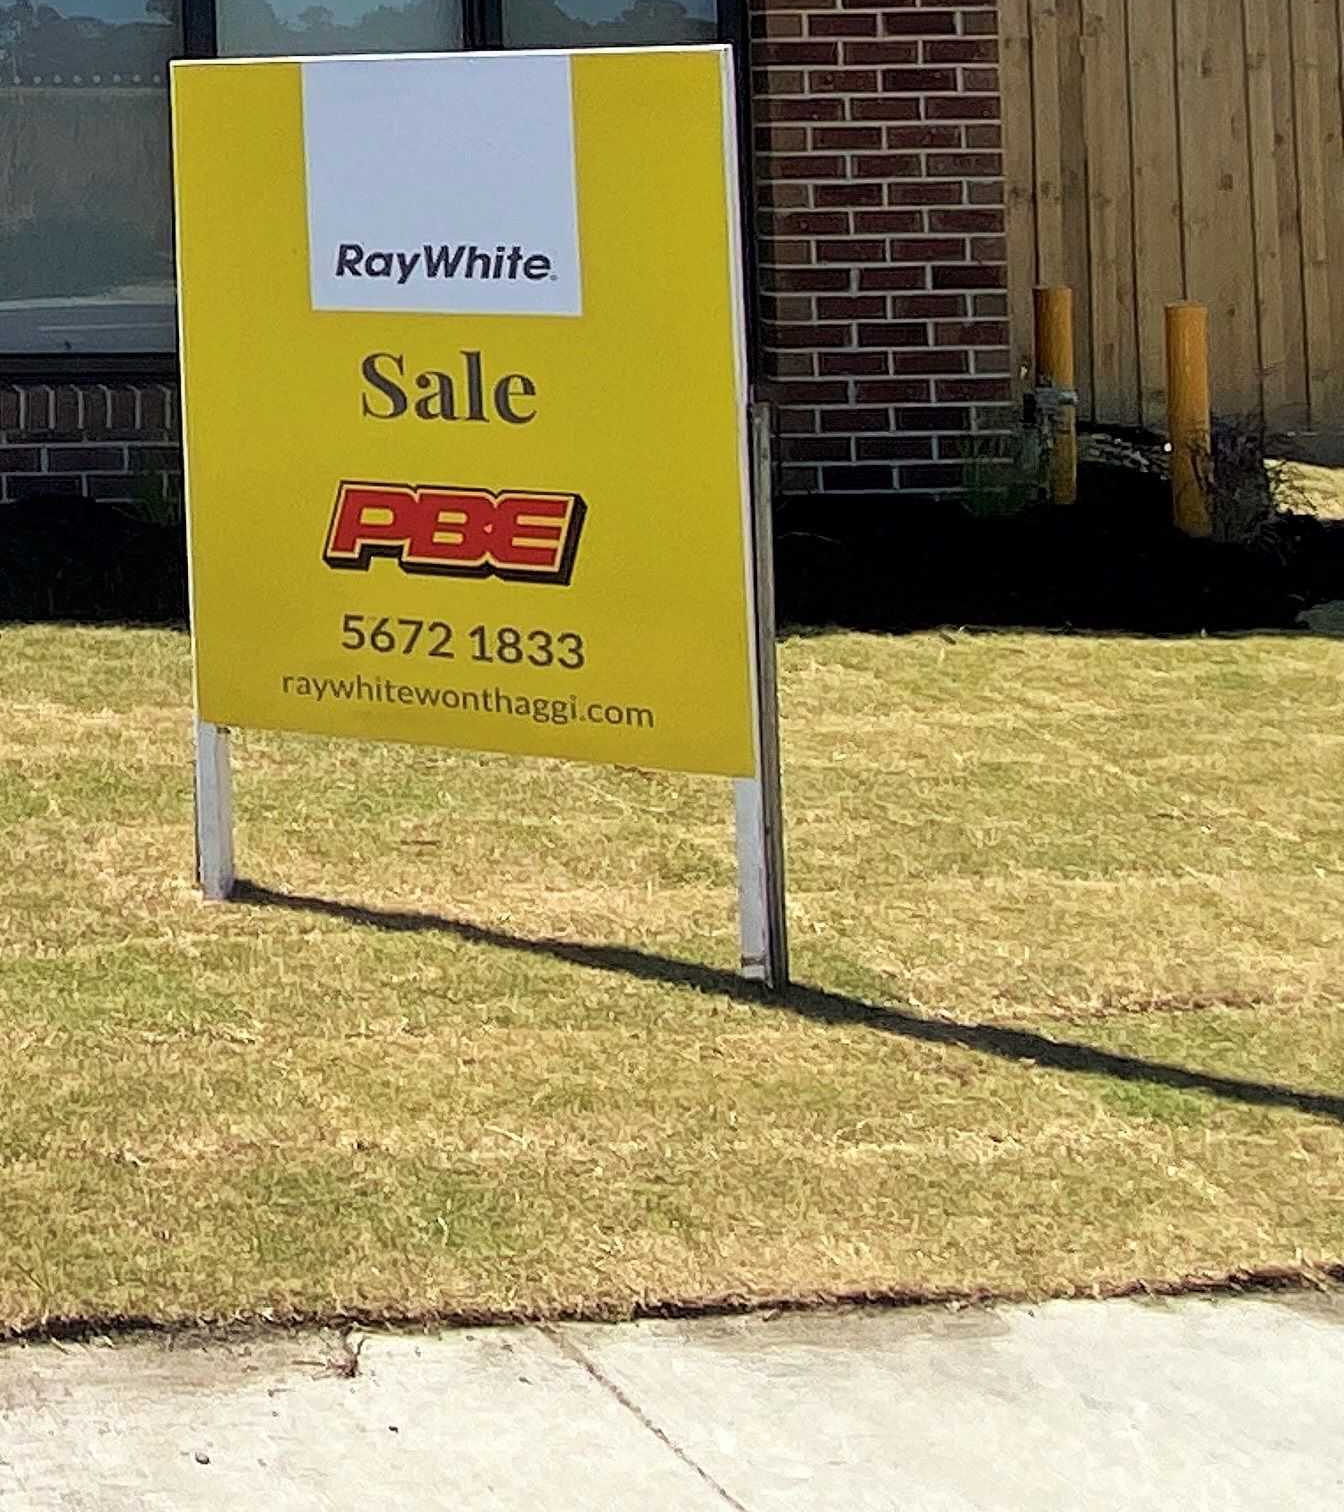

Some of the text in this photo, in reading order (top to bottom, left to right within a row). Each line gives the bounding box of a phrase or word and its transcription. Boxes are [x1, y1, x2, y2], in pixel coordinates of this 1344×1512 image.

[361, 350, 537, 424] Sale
[323, 480, 588, 585] PBE
[341, 614, 584, 669] 5672 1833
[282, 673, 654, 728] raywhitewonthaggi.com
